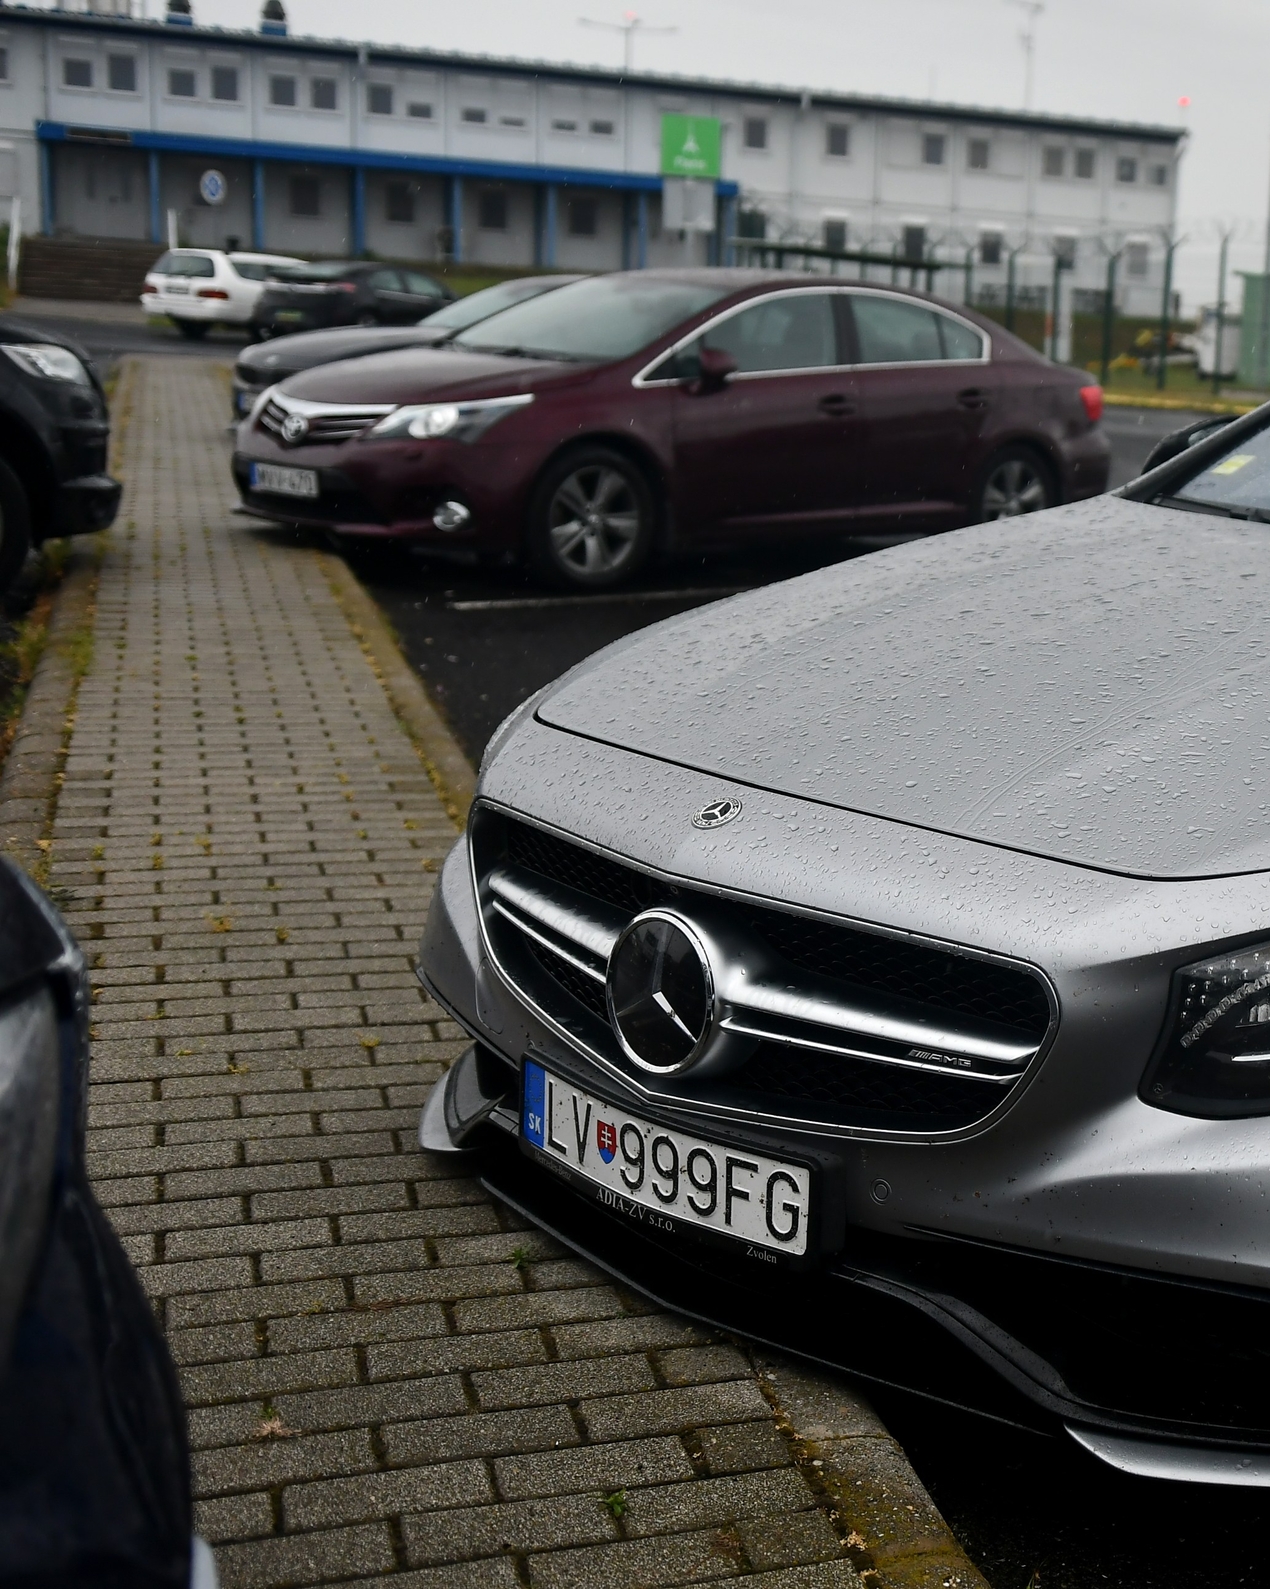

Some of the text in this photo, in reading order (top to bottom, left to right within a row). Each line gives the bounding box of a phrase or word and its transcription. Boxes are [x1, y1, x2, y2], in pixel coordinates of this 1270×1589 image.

[926, 1052, 972, 1068] AMG
[528, 1112, 541, 1134] SK
[596, 1188, 676, 1233] ADIA-ZV s.r.o.
[747, 1246, 778, 1264] Zvolen
